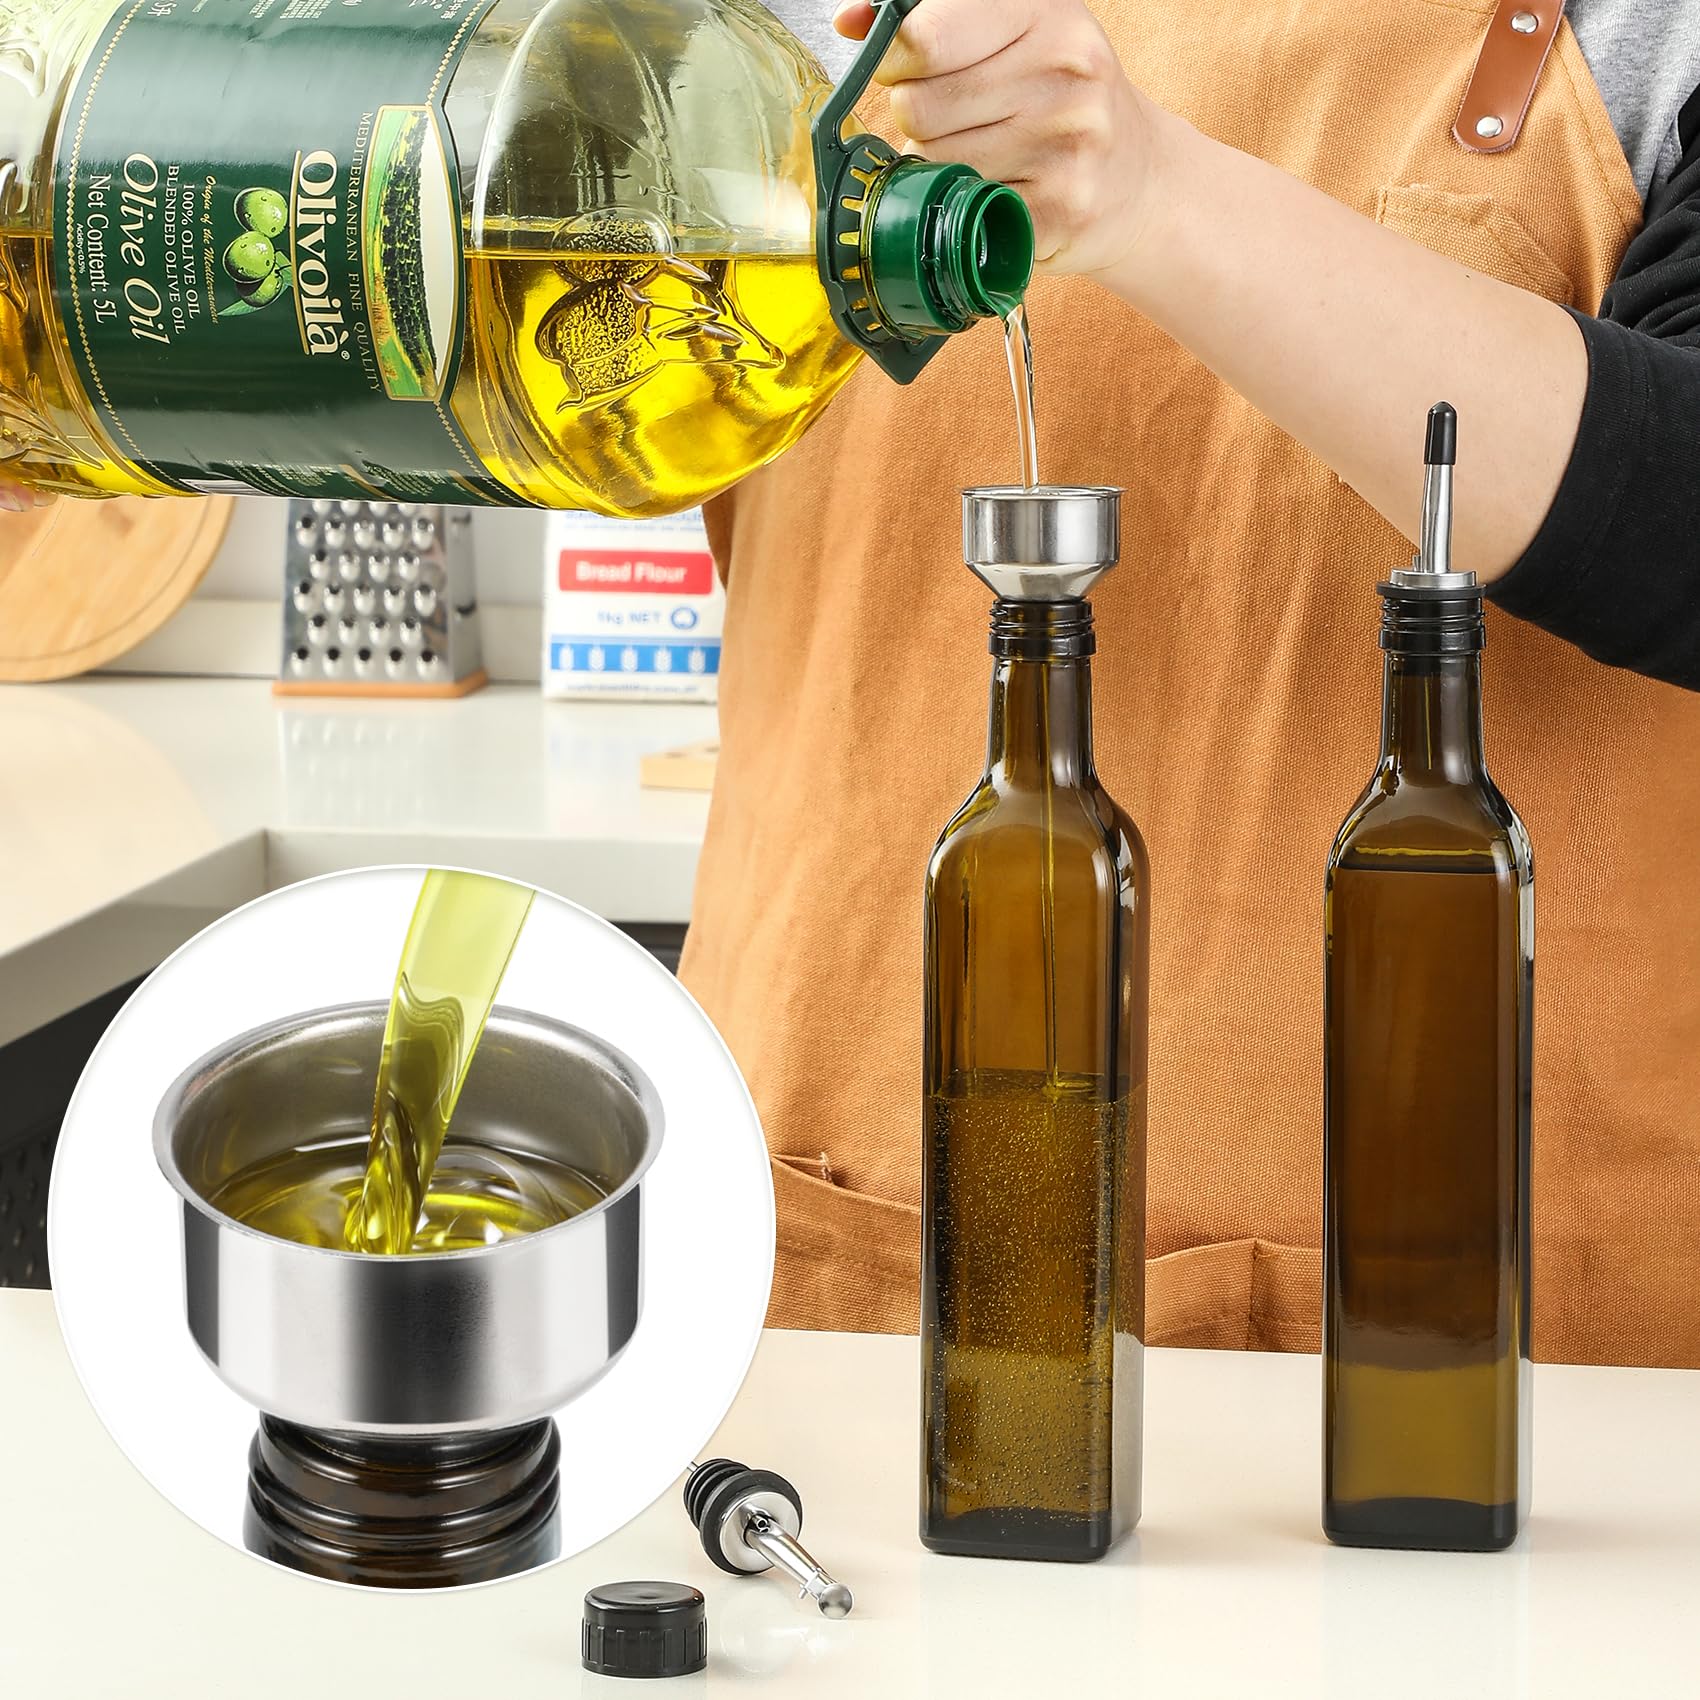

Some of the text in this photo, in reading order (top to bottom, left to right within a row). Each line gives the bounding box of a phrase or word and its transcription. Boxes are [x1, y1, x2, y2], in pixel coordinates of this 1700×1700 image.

[86, 173, 118, 324] Net Content: 5L
[119, 153, 171, 346] Olive Oil
[164, 165, 186, 335] BLENDED OLIVE OIL
[181, 184, 201, 320] 100% OLIVE OIL
[199, 175, 218, 325] Origin of the Mediterranean
[346, 111, 382, 393] MEDITERRANEAN FINE QUALITY
[576, 561, 687, 583] Bread Flour
[628, 610, 662, 625] NET
